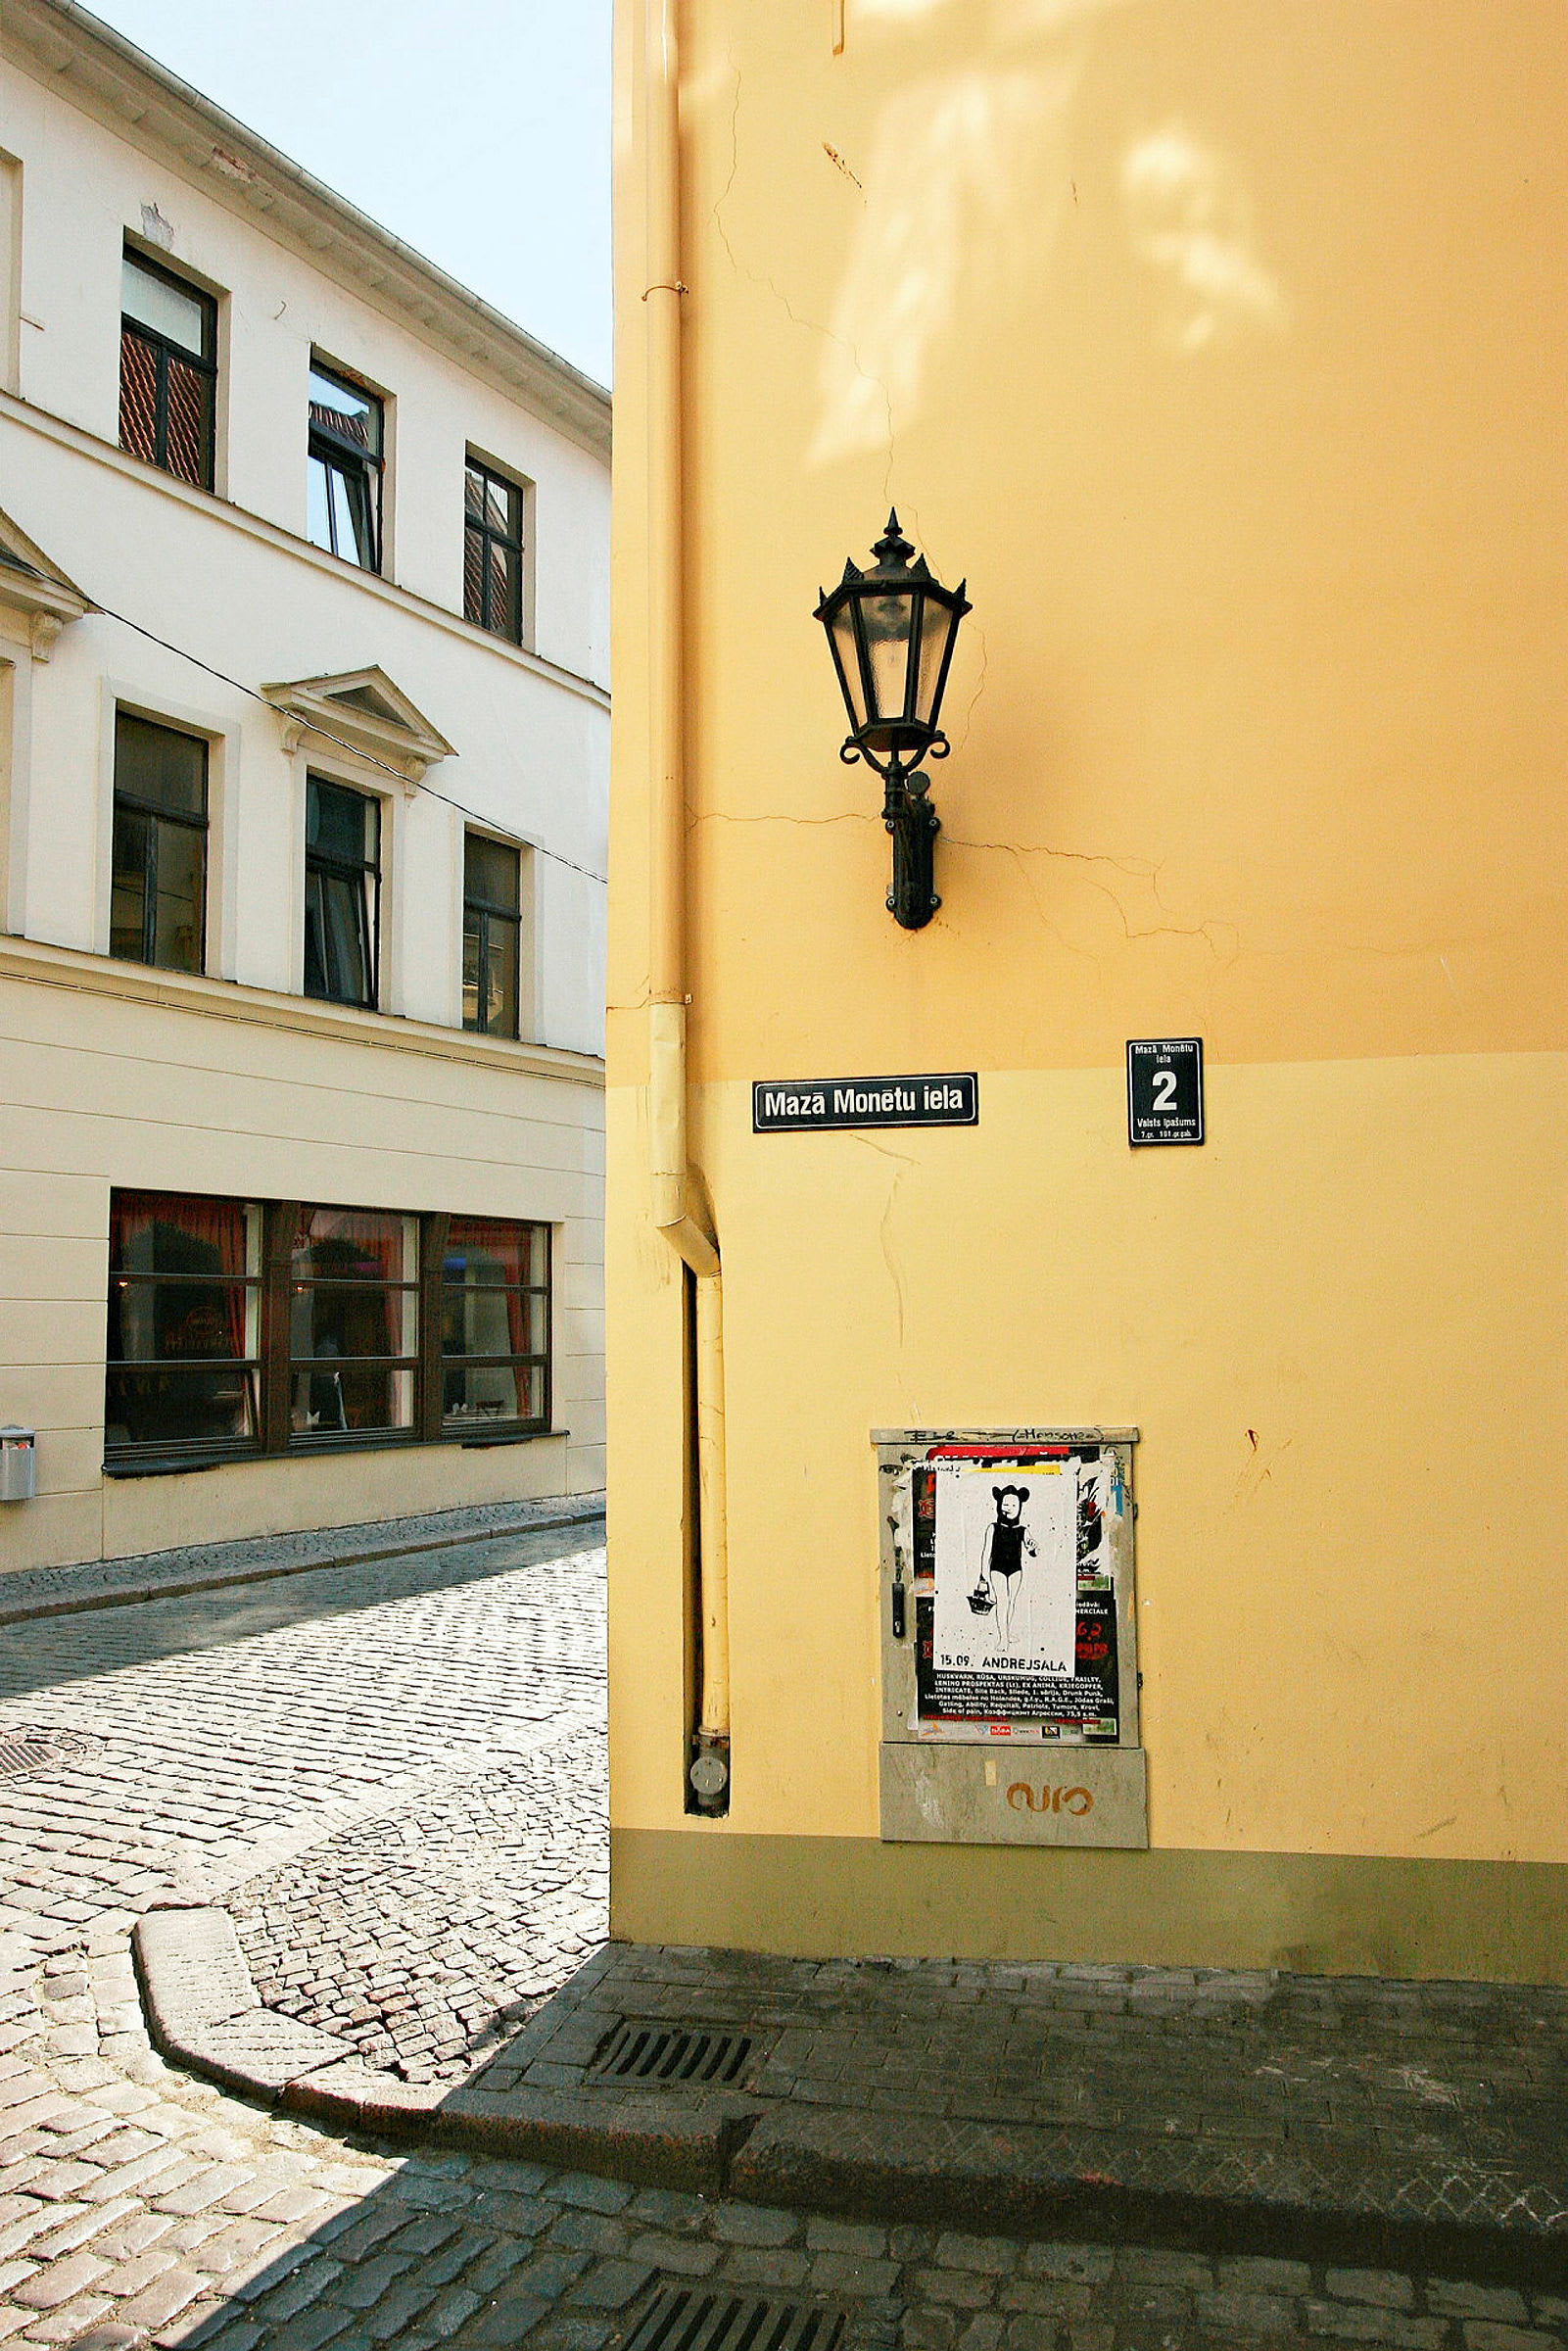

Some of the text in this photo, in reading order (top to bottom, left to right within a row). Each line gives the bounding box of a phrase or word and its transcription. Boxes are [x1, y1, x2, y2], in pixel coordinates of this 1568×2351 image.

[765, 1084, 964, 1117] Mazā Monētu iela
[1153, 1071, 1177, 1111] 2
[1137, 1118, 1161, 1128] Valsts
[940, 1655, 1068, 1672] 15.09. ANDREJSALA
